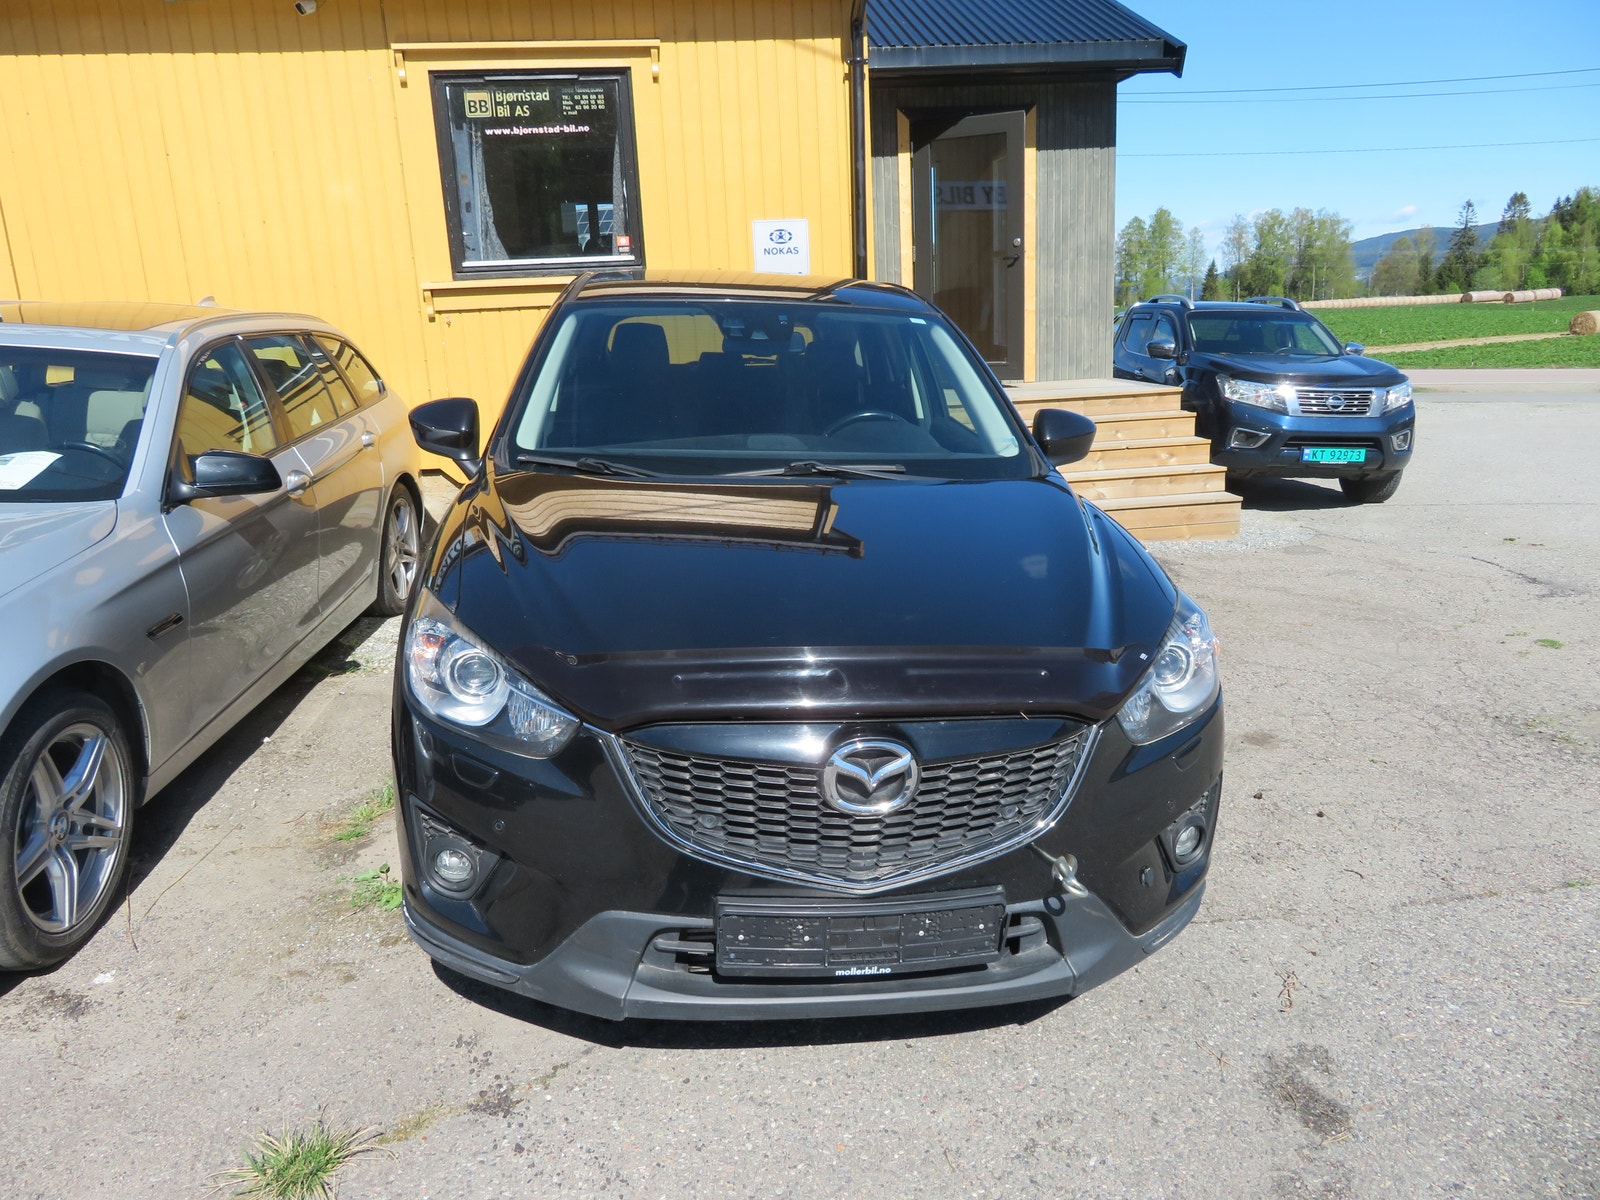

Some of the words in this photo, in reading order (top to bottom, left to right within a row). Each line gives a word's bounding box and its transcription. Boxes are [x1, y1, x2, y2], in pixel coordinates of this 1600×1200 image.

[495, 89, 550, 104] Bjørnstad
[468, 99, 489, 114] BB
[497, 105, 510, 117] Bil
[515, 105, 530, 117] AS
[485, 124, 590, 136] www.bjornstad-bil.no
[763, 246, 799, 256] NOKAS
[1311, 450, 1325, 460] KT
[1330, 450, 1362, 461] 92973
[835, 966, 892, 976] mollerbil.no
